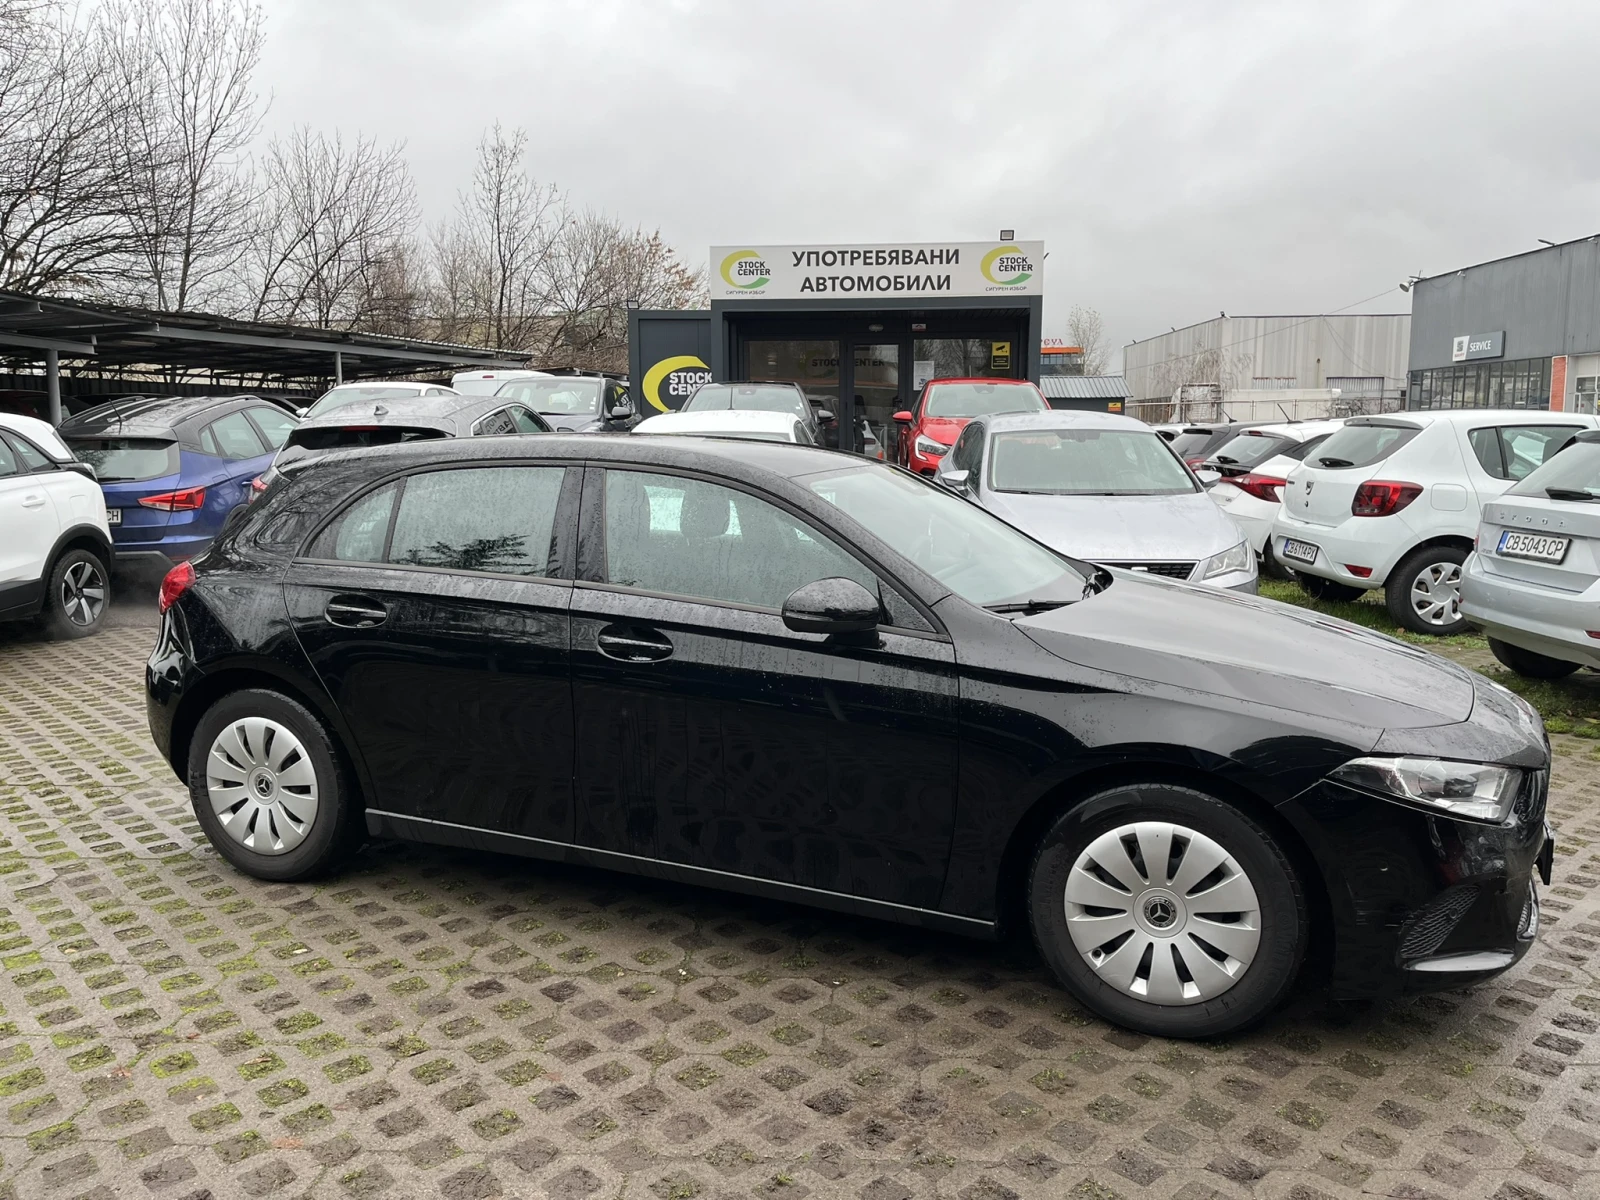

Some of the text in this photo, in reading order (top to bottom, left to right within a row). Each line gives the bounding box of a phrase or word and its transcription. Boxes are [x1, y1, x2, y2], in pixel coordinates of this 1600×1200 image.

[792, 249, 960, 267] УПОТРЕБЯВАНИ
[999, 257, 1028, 265] STOCK
[738, 261, 766, 269] STOCK
[998, 264, 1033, 272] CENTER
[737, 268, 771, 276] CENTER
[799, 274, 951, 293] АВТОМОБИЛИ
[1469, 340, 1492, 352] SERVICE
[669, 372, 713, 383] STOCK
